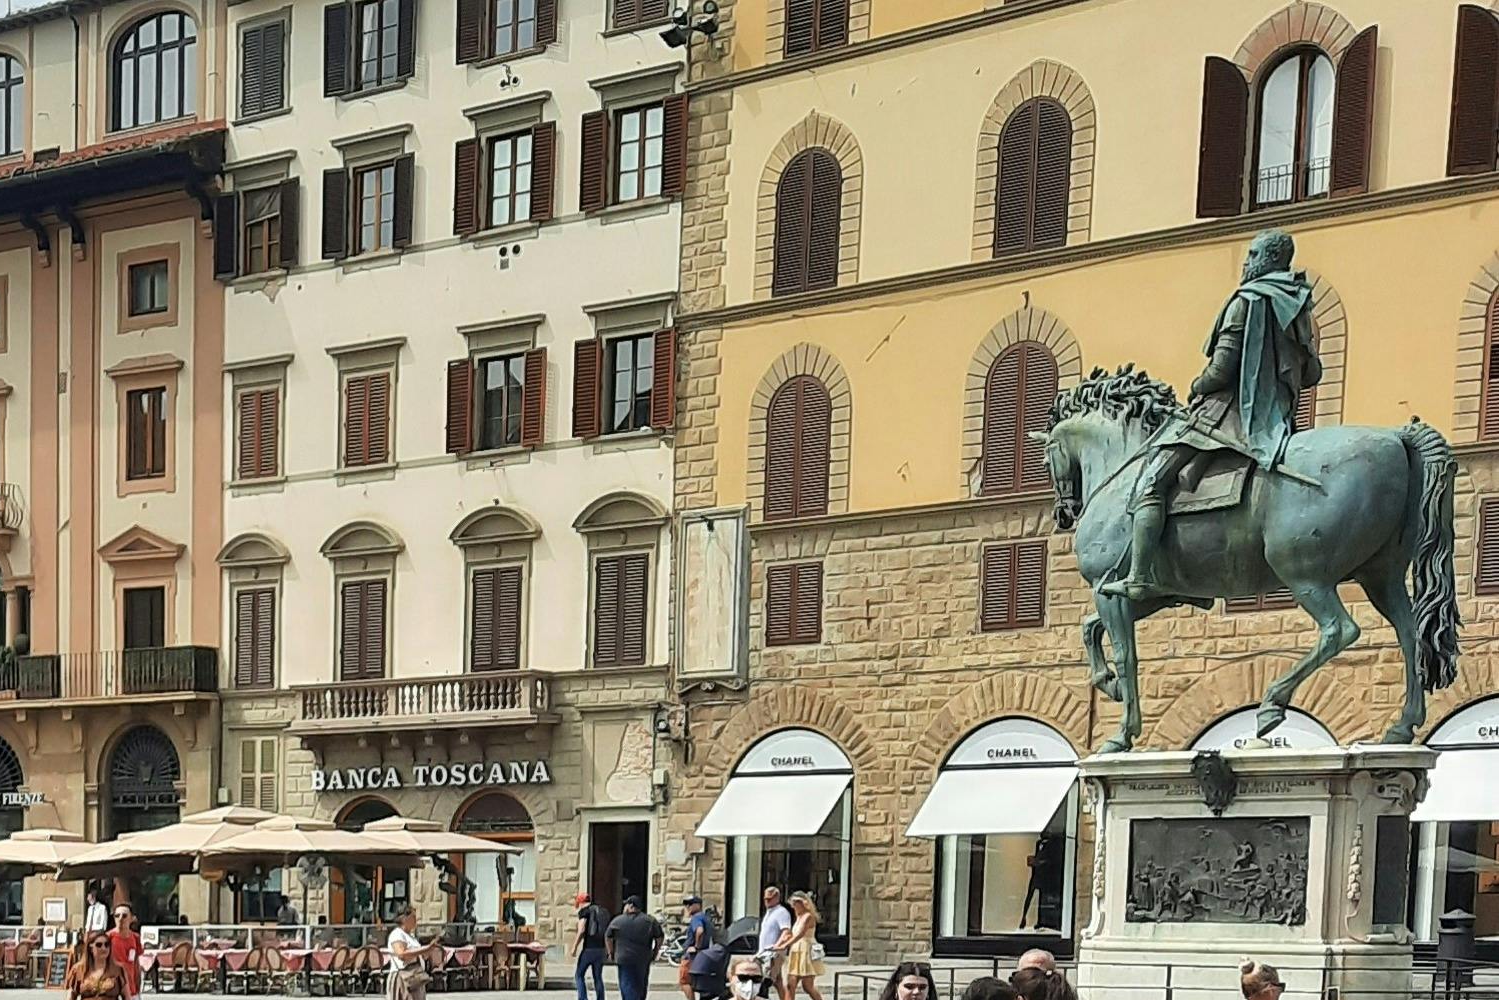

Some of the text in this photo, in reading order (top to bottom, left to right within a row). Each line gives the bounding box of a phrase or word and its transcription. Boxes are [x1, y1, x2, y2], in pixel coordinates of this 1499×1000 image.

[987, 748, 1037, 758] CHANEL
[771, 757, 815, 766] CHANEL
[310, 760, 550, 791] BANCA TOSCANA
[2, 791, 44, 806] FIRENZE
